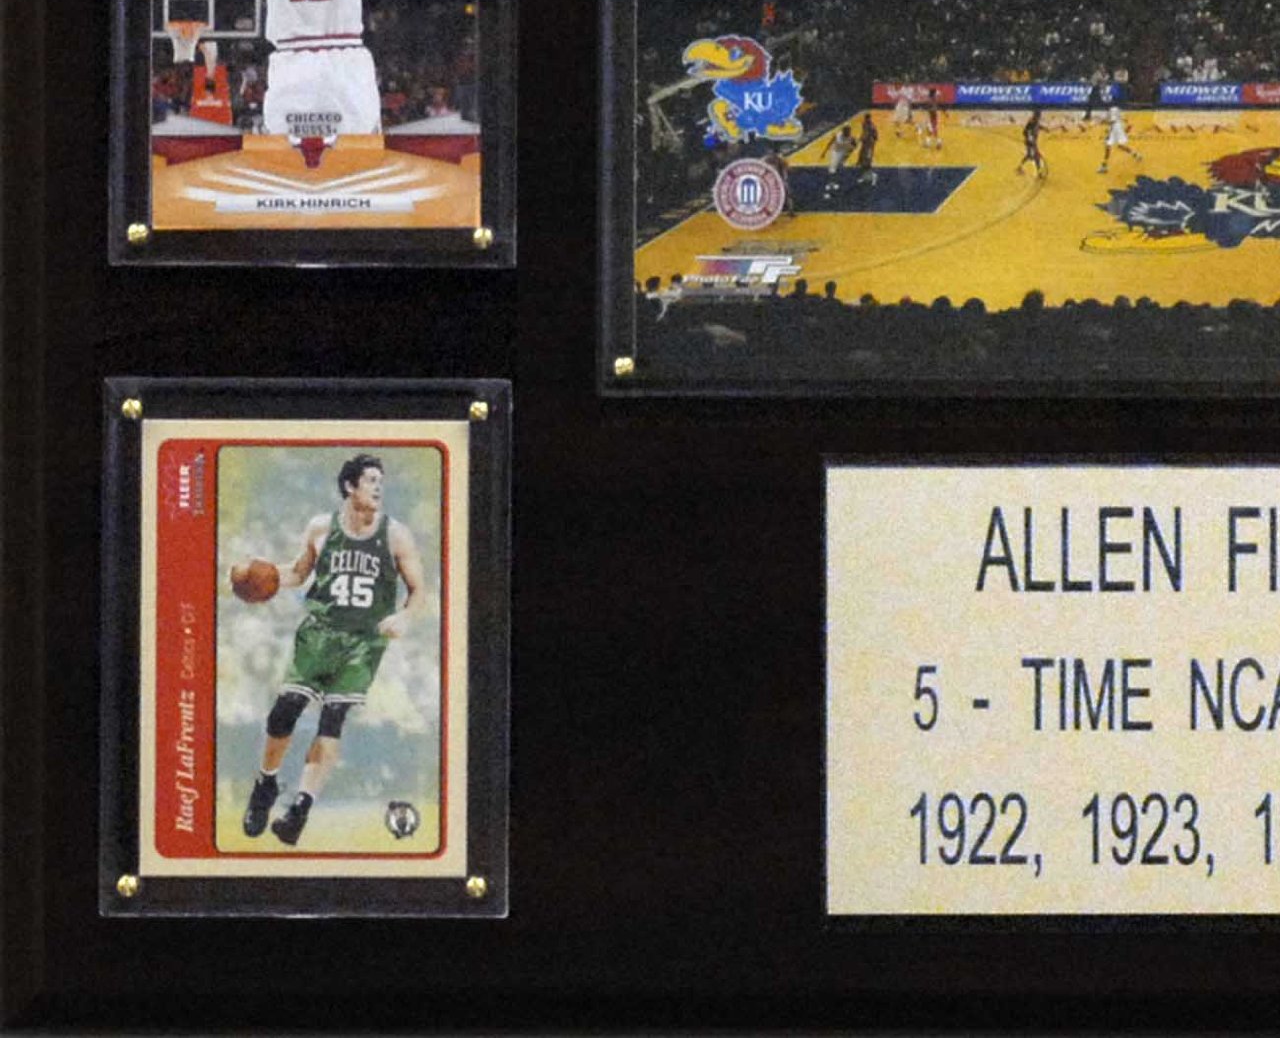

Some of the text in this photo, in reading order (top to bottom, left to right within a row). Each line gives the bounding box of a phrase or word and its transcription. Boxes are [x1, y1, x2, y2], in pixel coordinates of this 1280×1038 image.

[743, 92, 773, 112] KU
[959, 85, 1032, 95] MIDWEST
[1165, 85, 1238, 95] MIDWEST
[286, 113, 342, 124] CHICAGO
[256, 198, 371, 208] KIRK HINRICH
[179, 465, 190, 508] FLEER
[329, 550, 380, 578] CELTICS
[977, 507, 1180, 592] ALLEN
[330, 574, 376, 608] 45
[914, 666, 939, 731] 5
[1021, 658, 1153, 731] TIME
[177, 689, 195, 782] LaFrentz
[910, 792, 1041, 877] 1922,
[1082, 792, 1214, 877] 1923,
